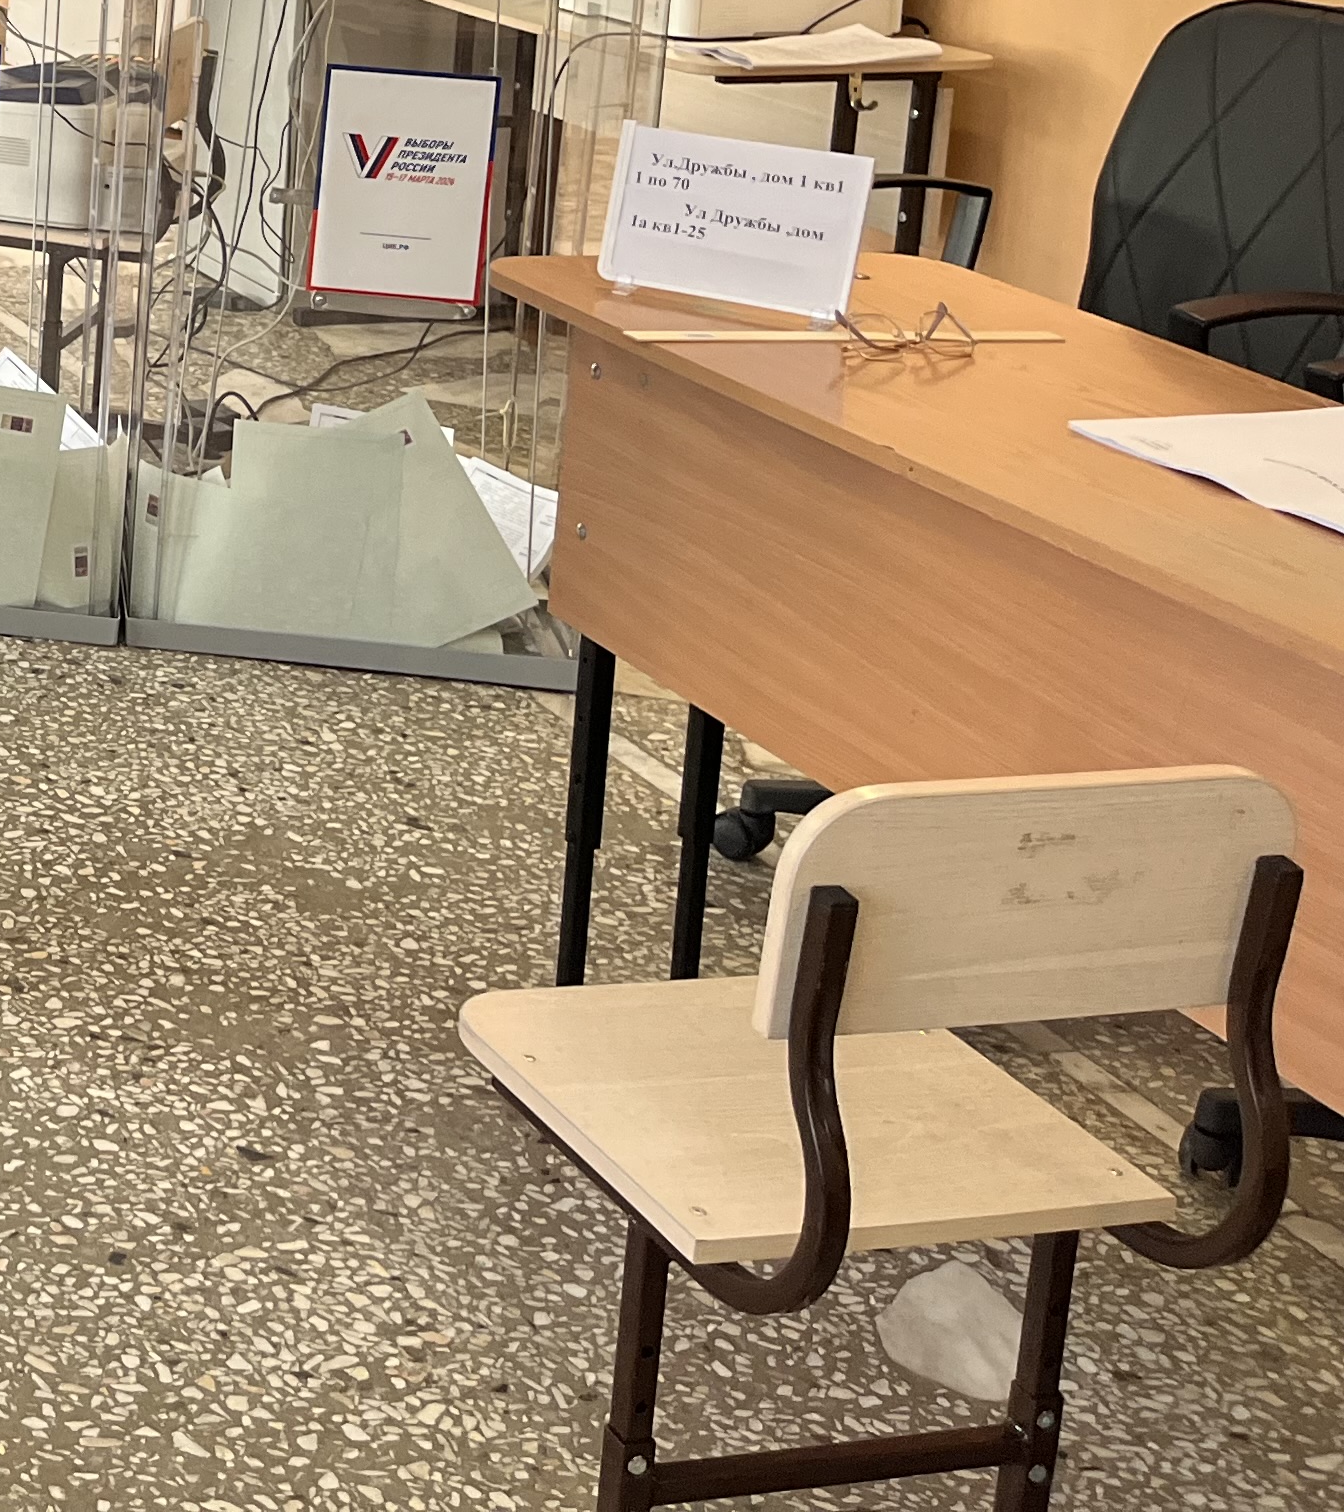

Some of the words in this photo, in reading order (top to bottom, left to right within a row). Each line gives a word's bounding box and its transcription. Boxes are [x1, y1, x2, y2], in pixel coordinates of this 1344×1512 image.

[404, 137, 454, 150] ВЫБОРЫ
[396, 149, 468, 164] ПРЕЗИДЕНТА
[390, 161, 436, 173] РОССИИ
[407, 174, 435, 185] МАРТА
[648, 176, 667, 187] по
[672, 176, 690, 191] 70
[760, 172, 793, 186] дом
[800, 175, 807, 187] 1
[814, 180, 844, 193] кв1
[685, 203, 707, 220] Ул
[710, 208, 781, 233] Дружбы
[631, 214, 647, 229] 1а
[652, 221, 707, 240] кв1-25
